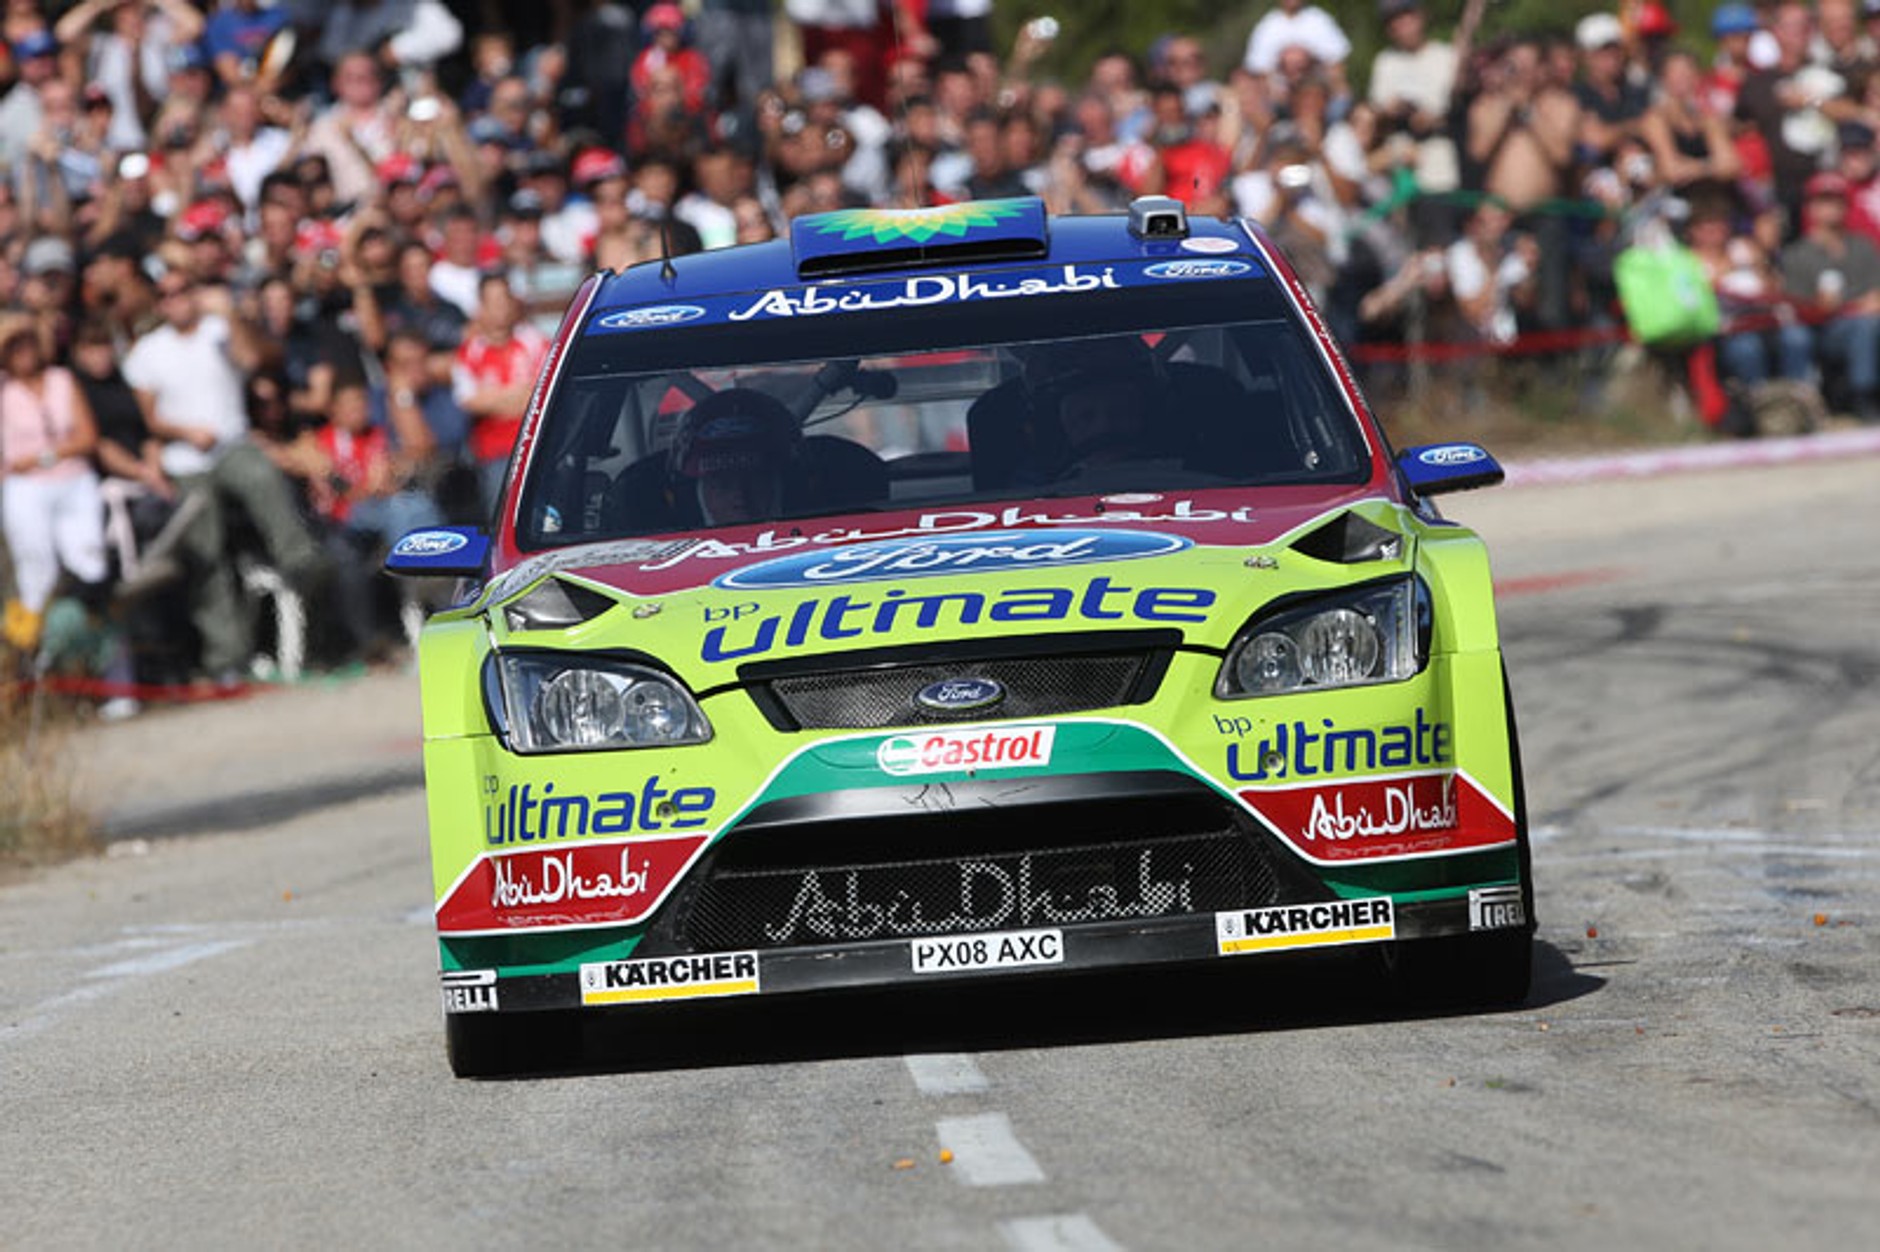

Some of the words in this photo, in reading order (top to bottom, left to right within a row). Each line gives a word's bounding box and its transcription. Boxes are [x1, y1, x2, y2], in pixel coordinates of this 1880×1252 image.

[1164, 263, 1231, 277] Ford
[617, 309, 683, 326] Ford
[803, 534, 1102, 580] Ford
[701, 577, 1216, 662] ultimate
[704, 602, 760, 622] bp
[937, 683, 982, 701] Ford
[1213, 714, 1252, 737] bp
[921, 730, 1042, 767] Castrol
[1227, 707, 1452, 780] ultimate
[485, 776, 716, 844] ultimate
[917, 939, 988, 968] PX08
[998, 934, 1057, 962] AXC
